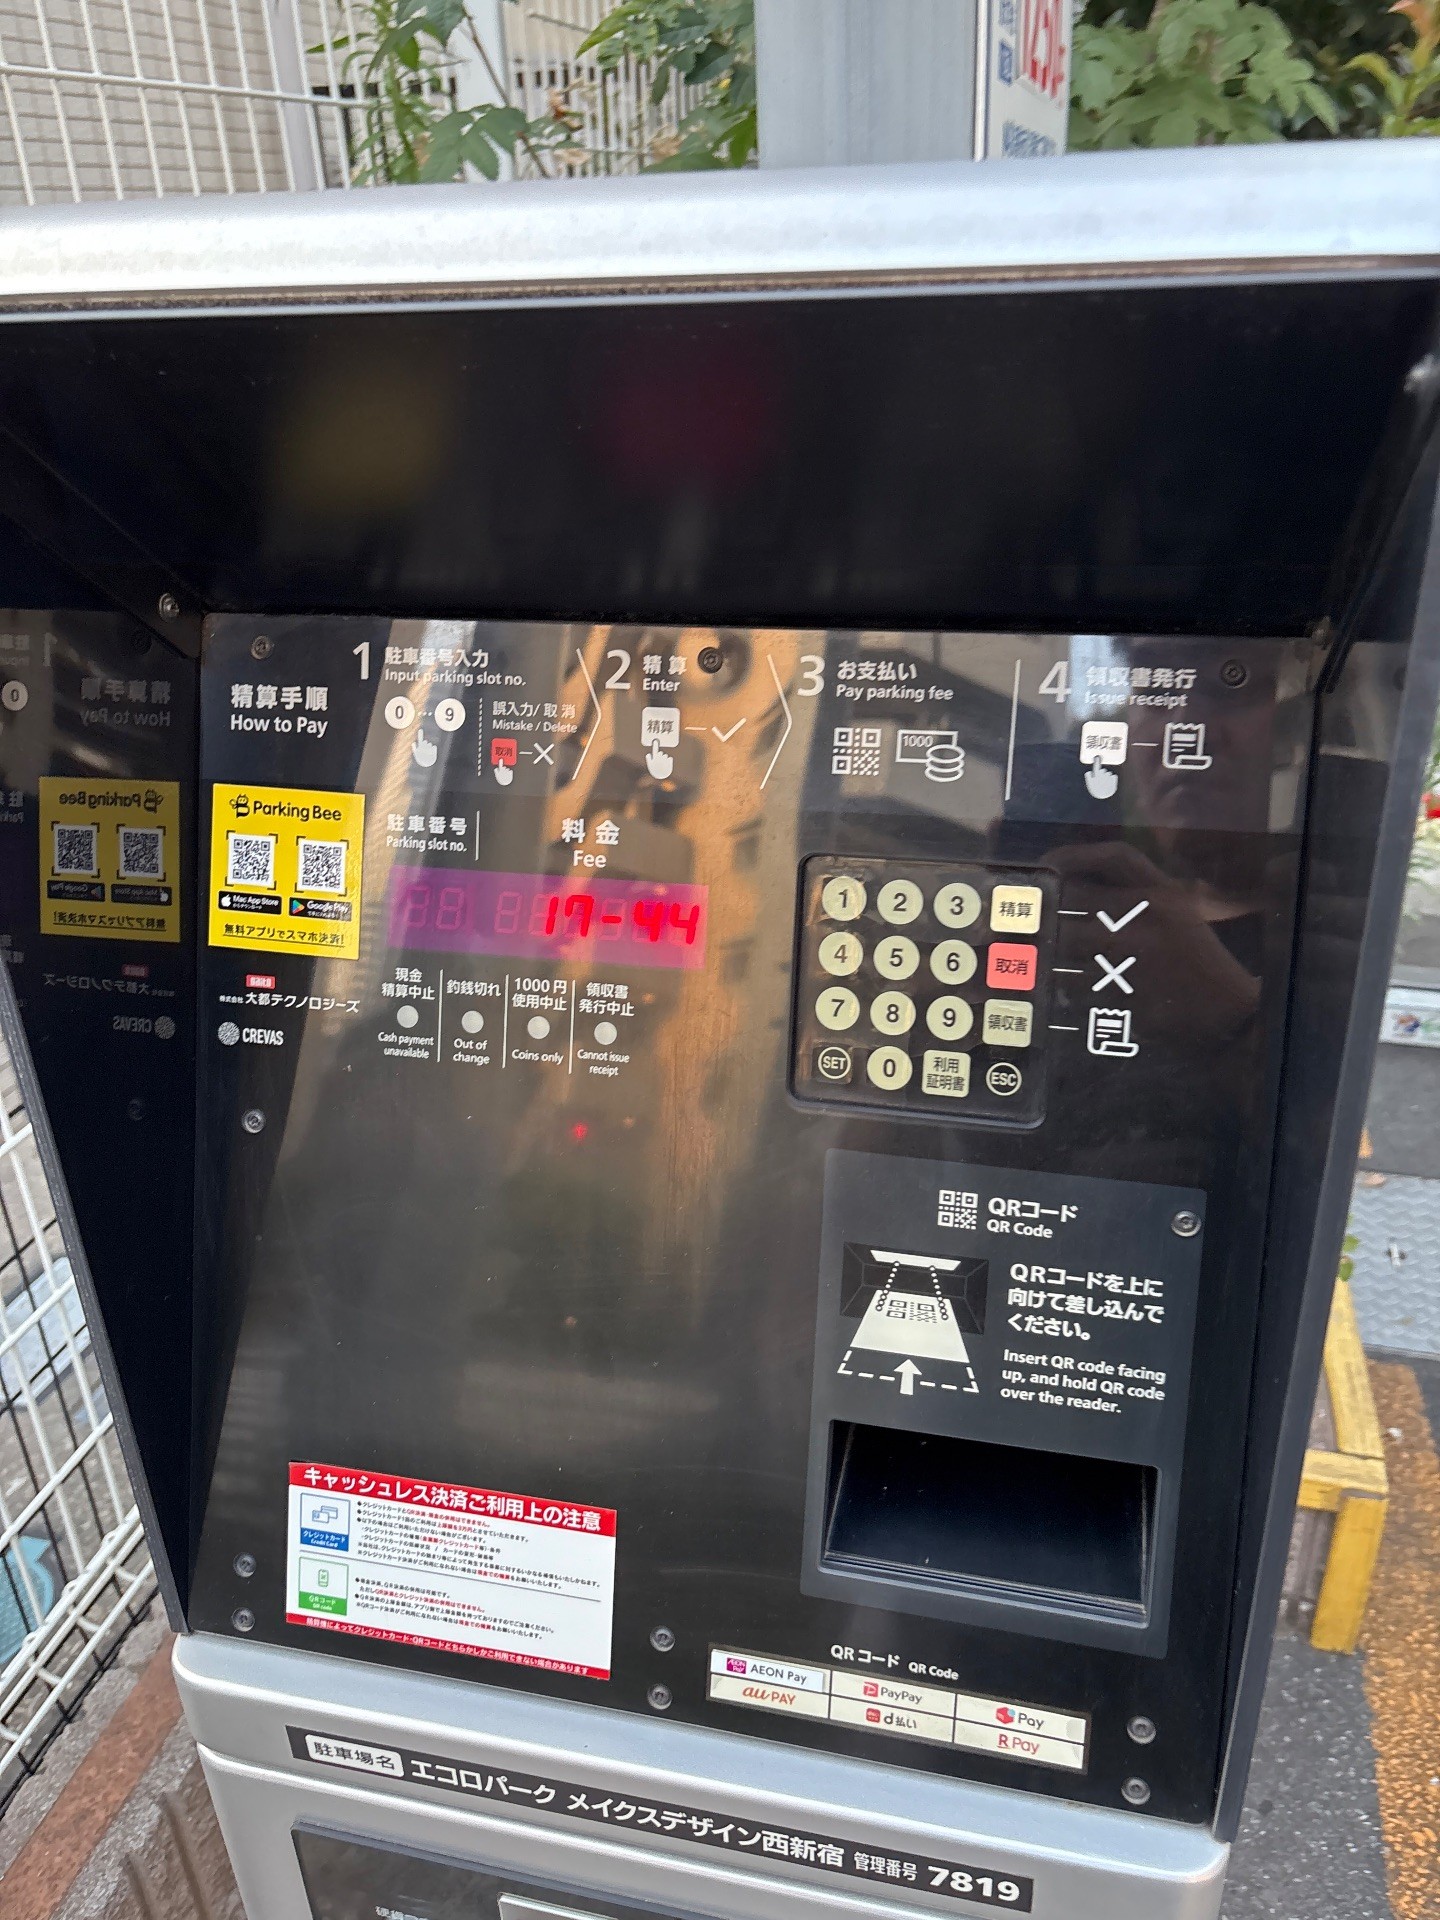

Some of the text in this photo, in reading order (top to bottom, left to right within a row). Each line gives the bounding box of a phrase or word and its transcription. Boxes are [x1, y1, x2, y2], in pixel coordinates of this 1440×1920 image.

[353, 642, 371, 680] 1
[385, 647, 489, 668] 駐車番号入力
[642, 654, 687, 676] 精算
[385, 669, 527, 687] Input parking slot no.
[606, 650, 631, 690] 2
[797, 655, 825, 697] 3
[837, 661, 918, 682] お支払い
[1086, 666, 1197, 689] 領収書発行
[642, 678, 681, 693] Enter
[1038, 661, 1071, 703] 4
[231, 684, 329, 711] 精算手順
[836, 685, 954, 703] Pay parking fee
[1129, 692, 1188, 709] receipt
[395, 706, 455, 721] 0 9
[231, 714, 328, 739] How to Pay
[492, 719, 533, 731] Mistake
[543, 722, 578, 733] Delete
[647, 718, 674, 735] 精算
[902, 735, 933, 747] 1000
[387, 814, 467, 836] 駐車番号
[562, 817, 620, 846] 料金
[386, 836, 467, 853] Parking slot no.
[573, 850, 607, 869] Fee
[307, 900, 333, 913] Google
[838, 890, 849, 908] 1
[894, 893, 907, 912] 2
[951, 896, 964, 915] 3
[999, 901, 1032, 918] 精算
[834, 944, 848, 963] 4
[890, 948, 903, 967] 5
[947, 953, 960, 972] 6
[395, 967, 423, 983] 現金
[996, 959, 1028, 976] 取消
[381, 982, 435, 1001] 精算中止
[447, 979, 501, 997] 釣銭切れ
[586, 982, 629, 999] 領収書
[246, 992, 360, 1013] 大都テクノロジーズ
[512, 994, 567, 1011] 使用中止
[579, 998, 635, 1017] 発行中止
[831, 999, 845, 1017] 7
[886, 1004, 899, 1022] 8
[943, 1008, 956, 1027] 9
[988, 1015, 1027, 1033] 領収書
[242, 1028, 284, 1046] CREVAS
[378, 1032, 434, 1046] Cash payment
[454, 1038, 488, 1051] Out of
[384, 1046, 430, 1059] unavailable
[453, 1052, 490, 1065] change
[512, 1049, 564, 1065] Coins only
[577, 1049, 630, 1063] Cannot issue
[589, 1064, 619, 1077] receipt
[823, 1057, 846, 1070] SET
[883, 1058, 896, 1077] 0
[934, 1057, 959, 1073] 利用
[927, 1075, 965, 1092] 証明書
[991, 1072, 1017, 1087] ESC
[988, 1197, 1079, 1222] QRコード
[987, 1219, 1053, 1239] QR Code
[1010, 1263, 1164, 1298] QRコードを上に
[1008, 1288, 1165, 1324] 向けて差し込んで
[1008, 1313, 1091, 1341] ください。
[1004, 1348, 1166, 1384] Insert QR code facing
[1002, 1371, 1165, 1401] up, and hold QR code
[1001, 1388, 1121, 1414] over the reader.
[303, 1466, 601, 1532] キャッシュレス決済ご利用上の注意
[303, 1530, 346, 1543] クレジットカード
[308, 1594, 336, 1606] QRコード
[751, 1664, 807, 1685] AEON Pay
[908, 1661, 959, 1680] QR Code
[881, 1686, 922, 1705] PayPay
[884, 1712, 917, 1729] d払い
[1018, 1712, 1044, 1730] Pay
[998, 1733, 1040, 1755] R Pay
[315, 1741, 395, 1770] 駐車場名
[411, 1758, 1020, 1902] エコロパーク メイクスデザイン西新宿 管理番号 7819
